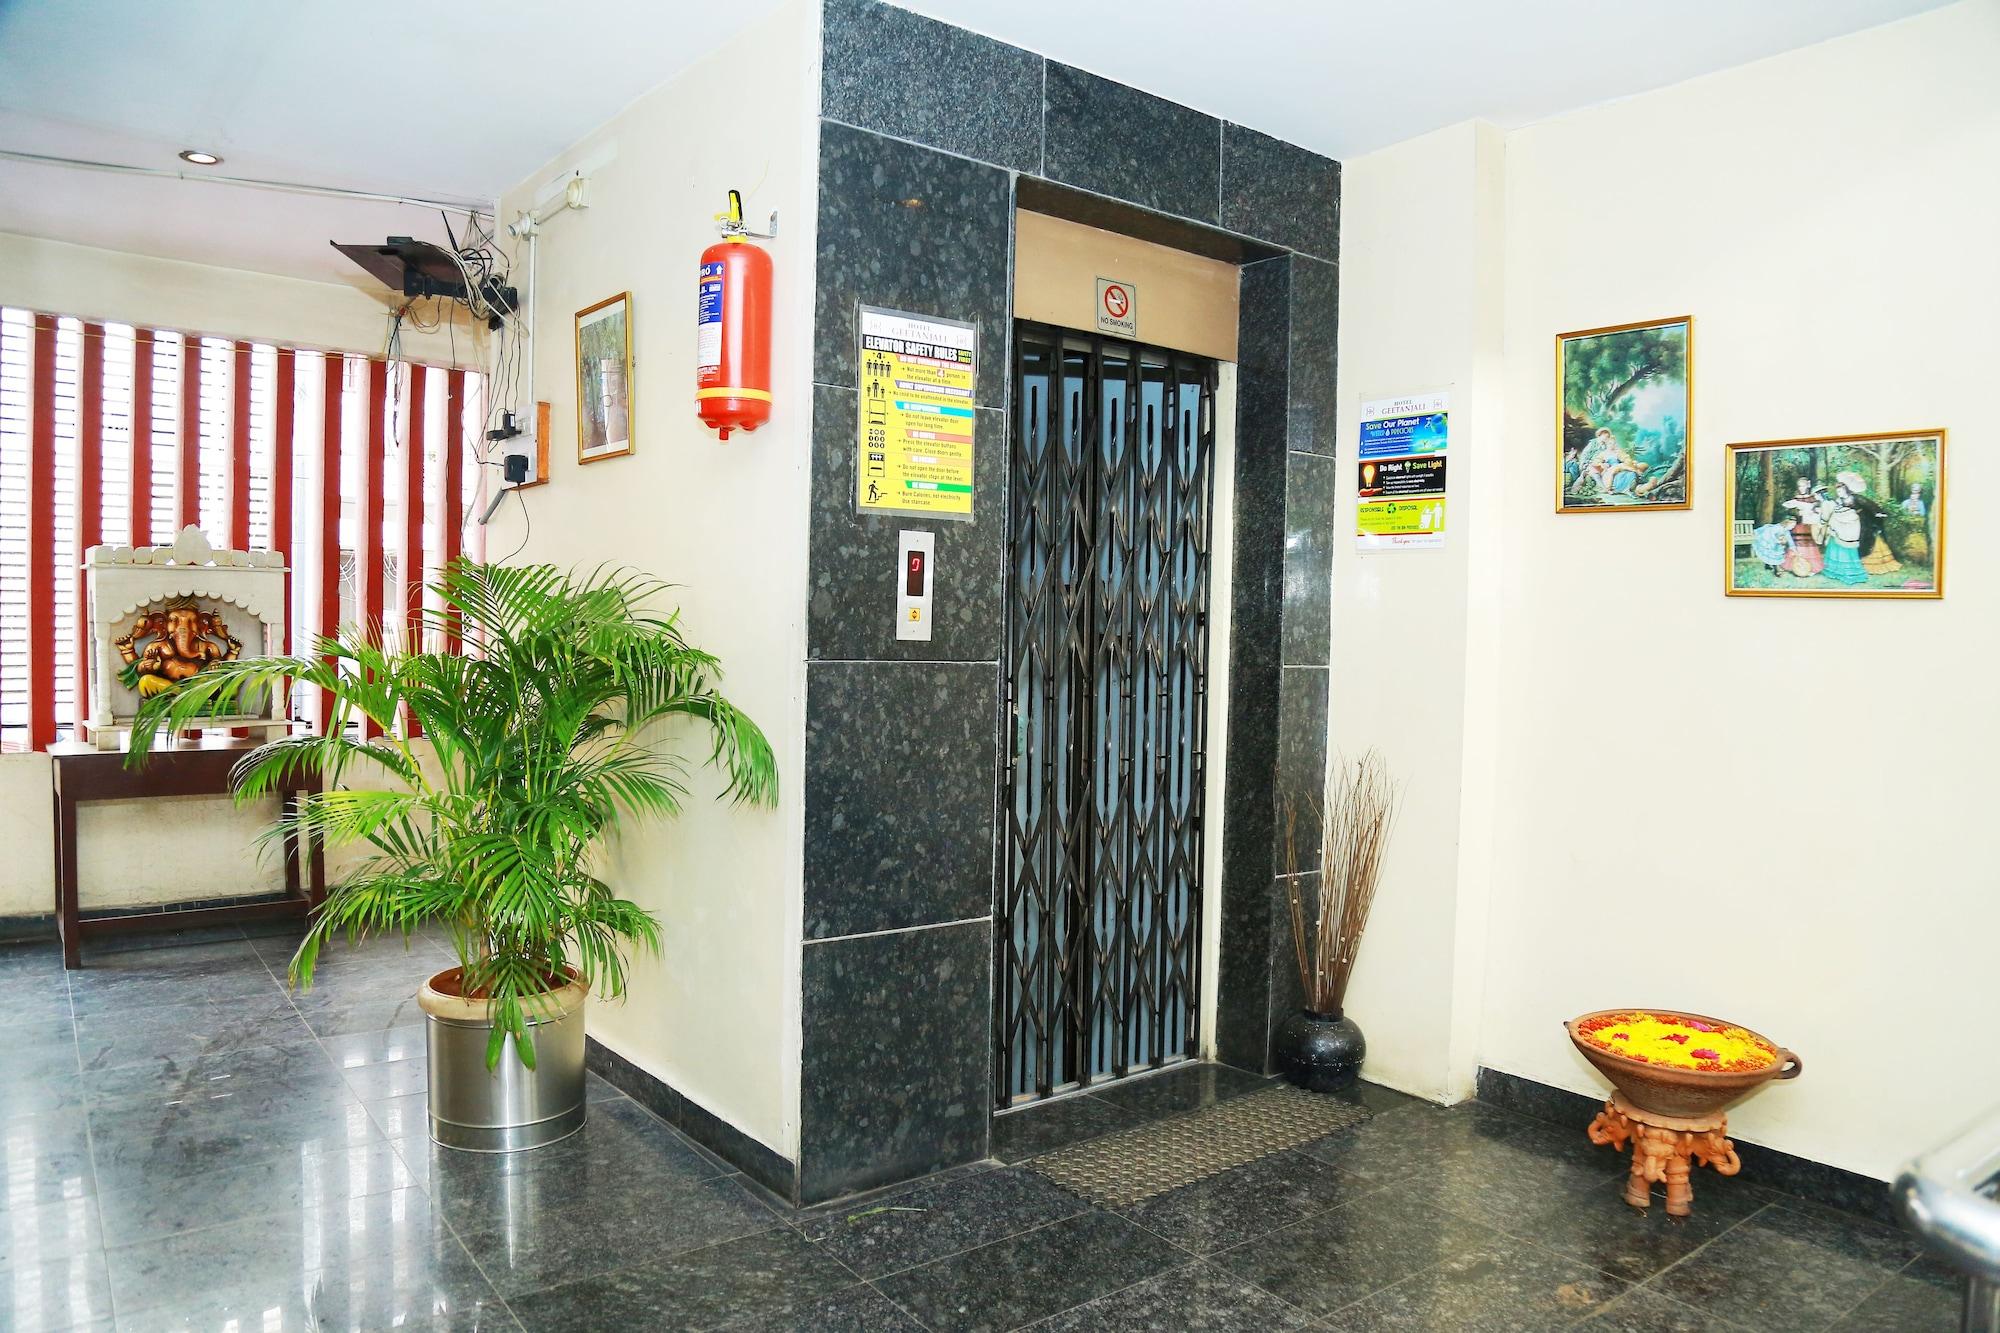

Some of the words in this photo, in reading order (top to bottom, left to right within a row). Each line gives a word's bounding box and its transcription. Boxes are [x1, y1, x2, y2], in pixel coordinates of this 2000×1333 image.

[908, 322, 930, 332] HOTEL
[1110, 318, 1134, 330] SMOKING
[892, 328, 947, 344] GEETANJALI
[866, 336, 904, 354] ELEVATOR
[905, 341, 934, 357] SAFETY
[934, 346, 958, 361] RULES
[1382, 404, 1426, 415] GEETANJALI
[1366, 422, 1382, 430] Save
[1383, 420, 1396, 428] Our
[1398, 417, 1420, 426] Planet
[1412, 462, 1427, 470] Save
[1428, 460, 1442, 470] Light
